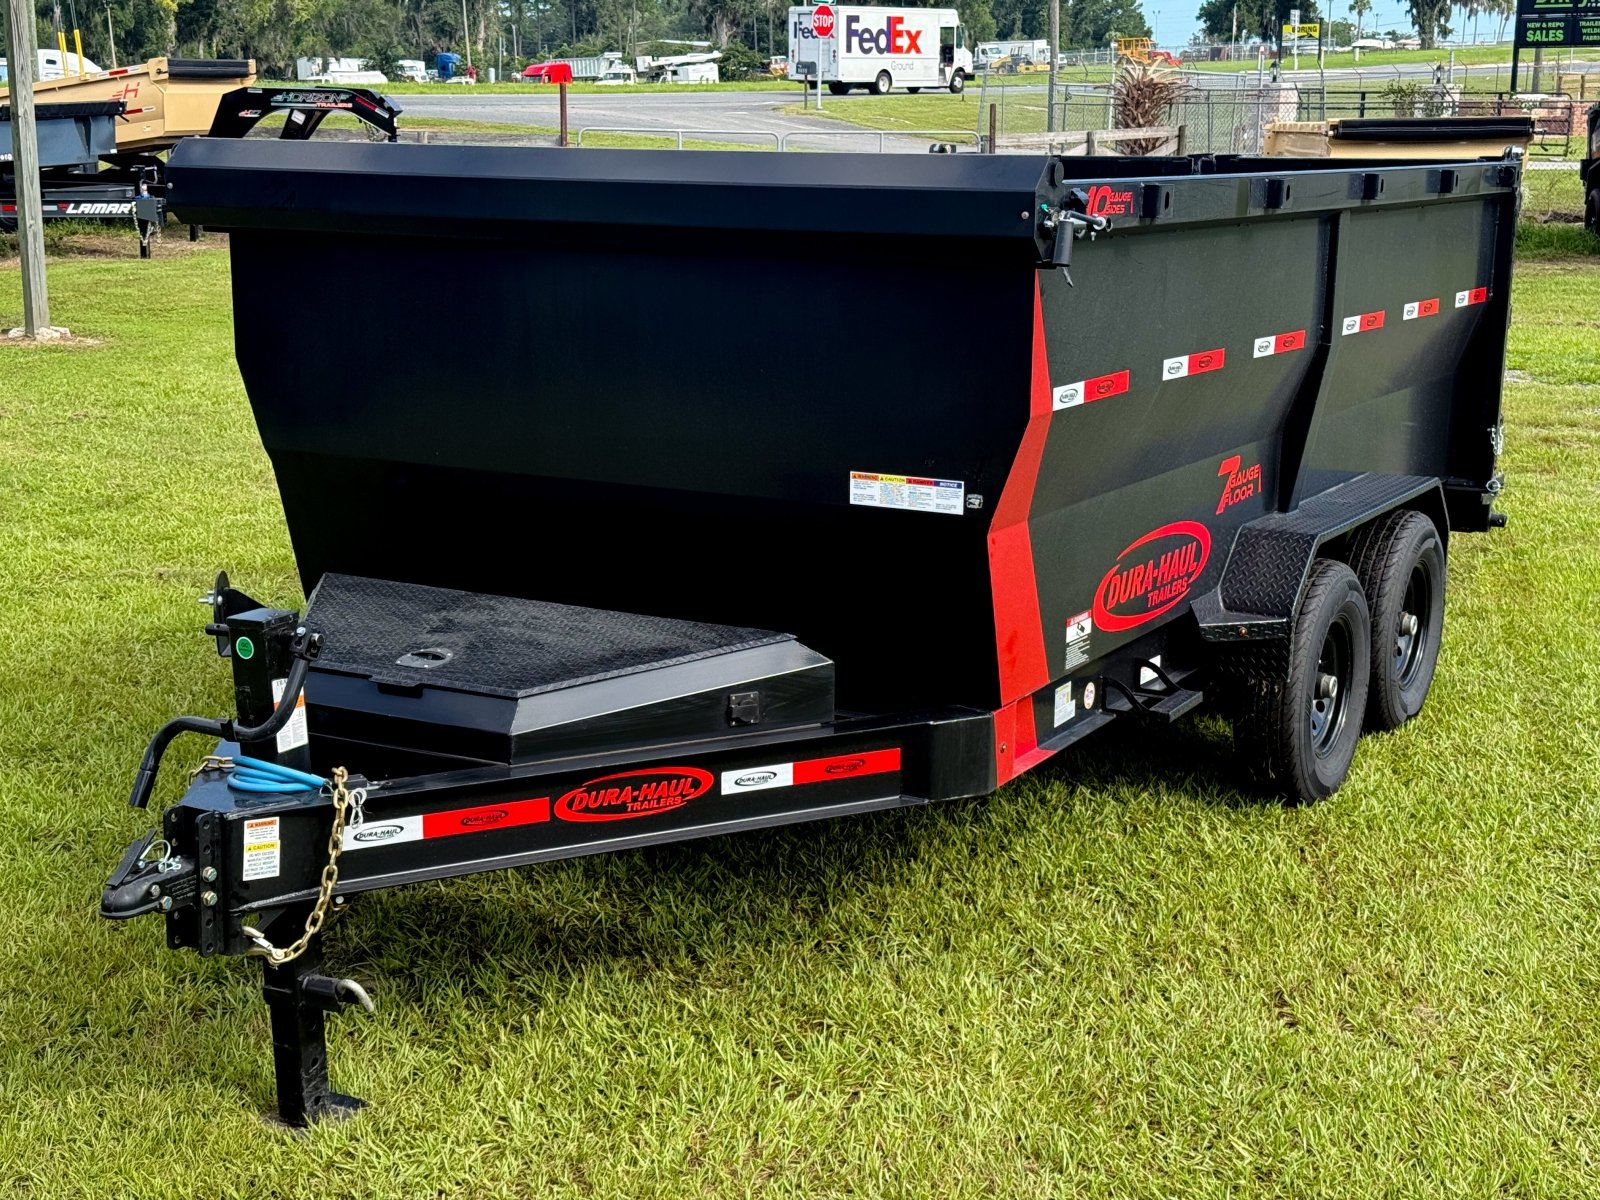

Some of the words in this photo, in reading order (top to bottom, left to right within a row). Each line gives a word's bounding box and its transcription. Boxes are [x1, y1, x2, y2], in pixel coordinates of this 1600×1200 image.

[814, 14, 833, 27] STOP
[846, 15, 922, 55] FedEx
[1526, 30, 1564, 41] SALES
[891, 60, 914, 71] Ground
[281, 92, 341, 102] HORIZON
[66, 203, 131, 214] LAMAR
[1086, 185, 1111, 217] 10
[1110, 192, 1132, 202] GAUGE
[1106, 205, 1126, 214] SIDES
[1216, 455, 1240, 515] 7
[1230, 464, 1260, 488] GAUGE
[1222, 483, 1254, 508] FLOOR
[1106, 541, 1197, 610] DURA-HAUL
[1147, 577, 1188, 608] TRAILERS
[572, 777, 695, 811] DURA-HAUL
[626, 796, 682, 812] TRAILERS
[359, 828, 400, 839] DURA-HAUL
